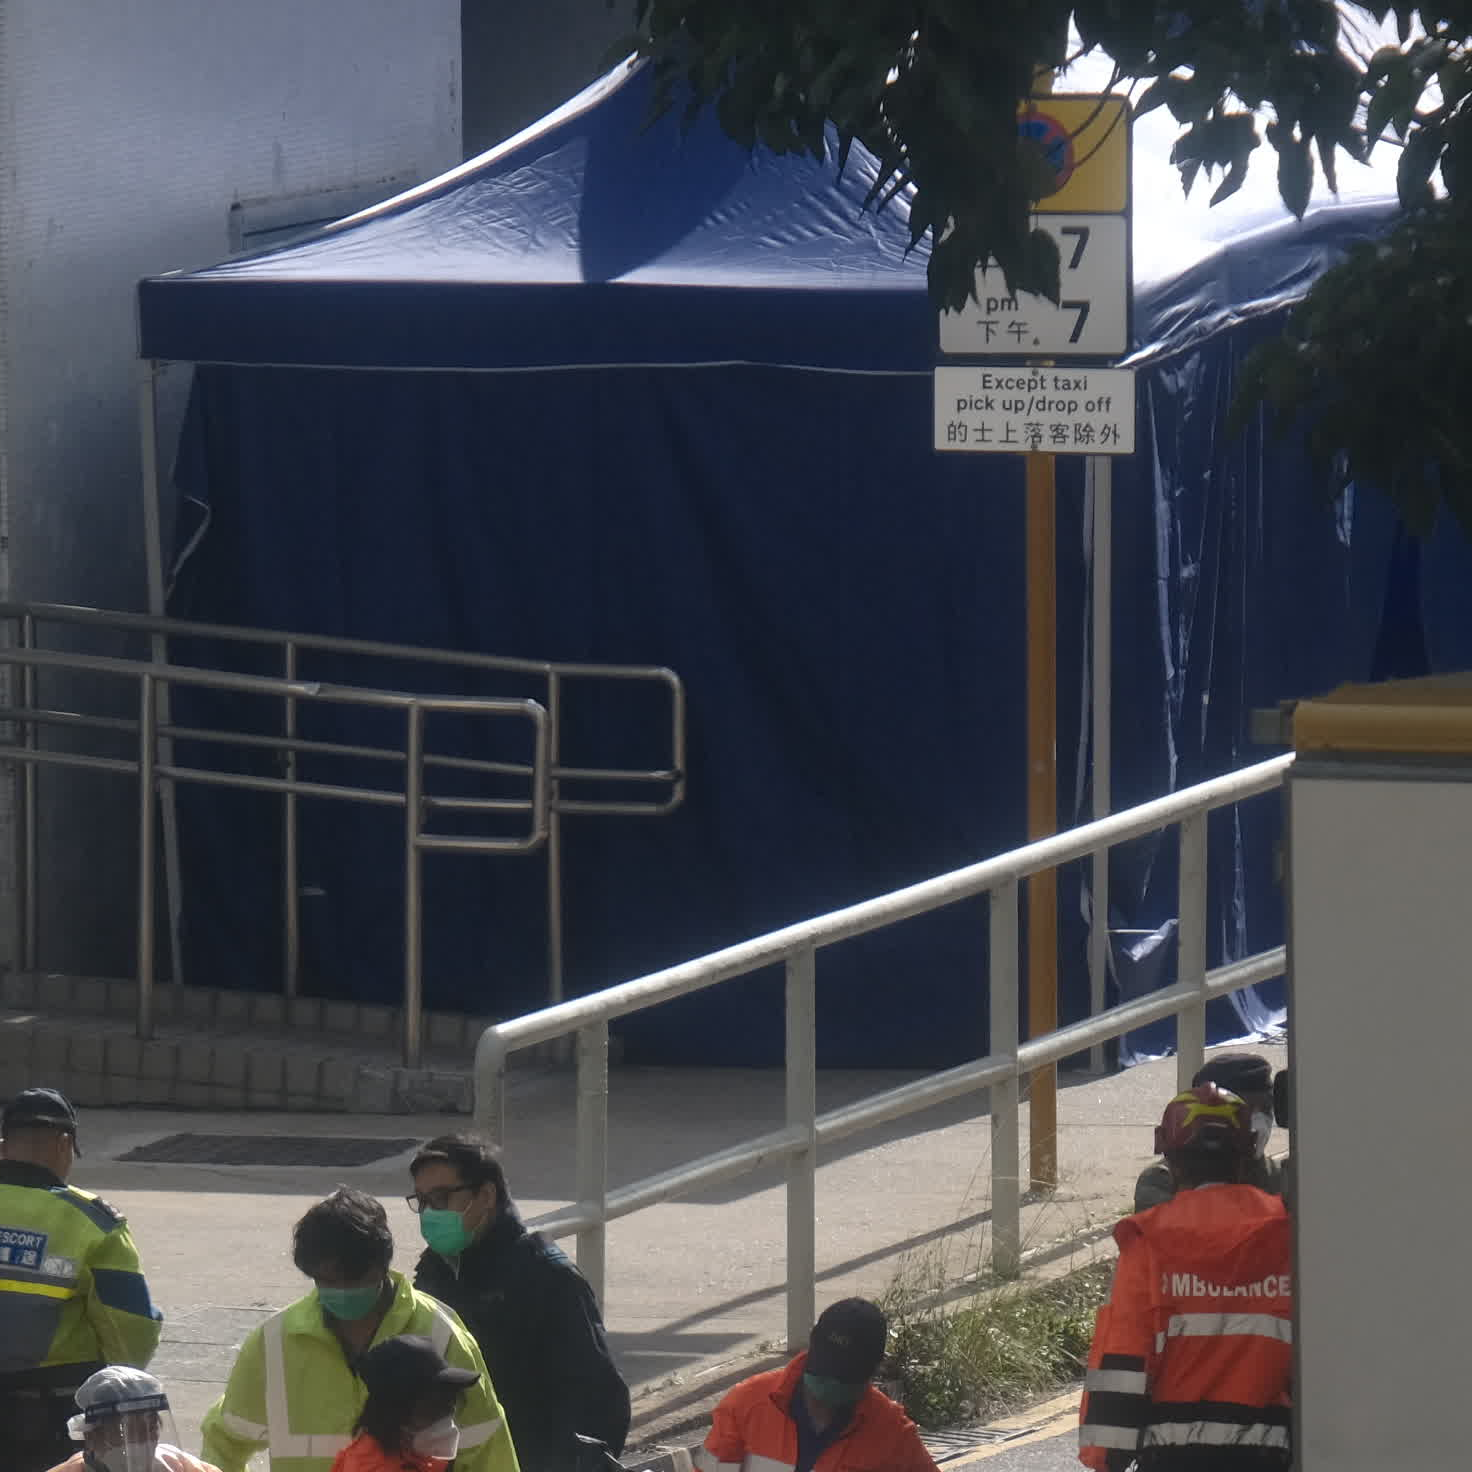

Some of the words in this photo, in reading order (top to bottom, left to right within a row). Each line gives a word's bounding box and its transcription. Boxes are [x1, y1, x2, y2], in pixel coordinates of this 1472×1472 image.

[1062, 227, 1090, 269] 7
[986, 296, 1019, 313] pm
[977, 320, 1029, 344] 下午
[1061, 301, 1090, 343] 7
[982, 375, 1046, 396] Except
[1053, 375, 1088, 390] taxi
[956, 397, 993, 417] pick
[1003, 397, 1078, 418] up/drop
[1084, 397, 1112, 412] off
[946, 421, 1120, 444] 的士上落客除外
[1160, 1272, 1293, 1299] MBULANCE
